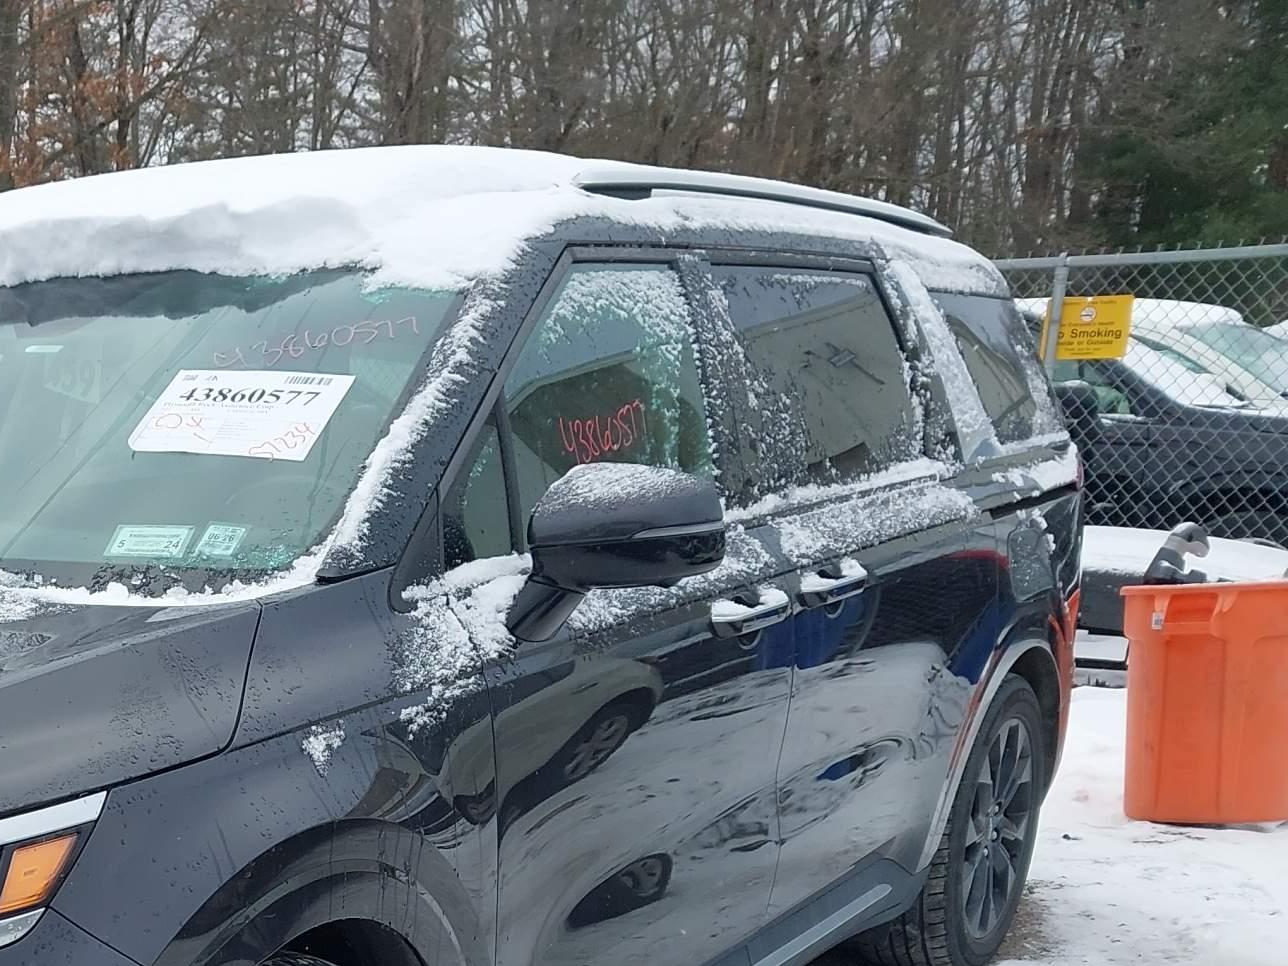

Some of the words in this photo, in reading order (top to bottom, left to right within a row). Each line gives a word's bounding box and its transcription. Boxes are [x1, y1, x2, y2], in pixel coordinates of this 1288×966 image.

[214, 316, 420, 368] 43860577
[1070, 328, 1122, 339] Smoking
[179, 387, 323, 406] 43860577
[559, 398, 648, 465] 43860577
[117, 539, 127, 549] 5
[163, 540, 181, 550] 24
